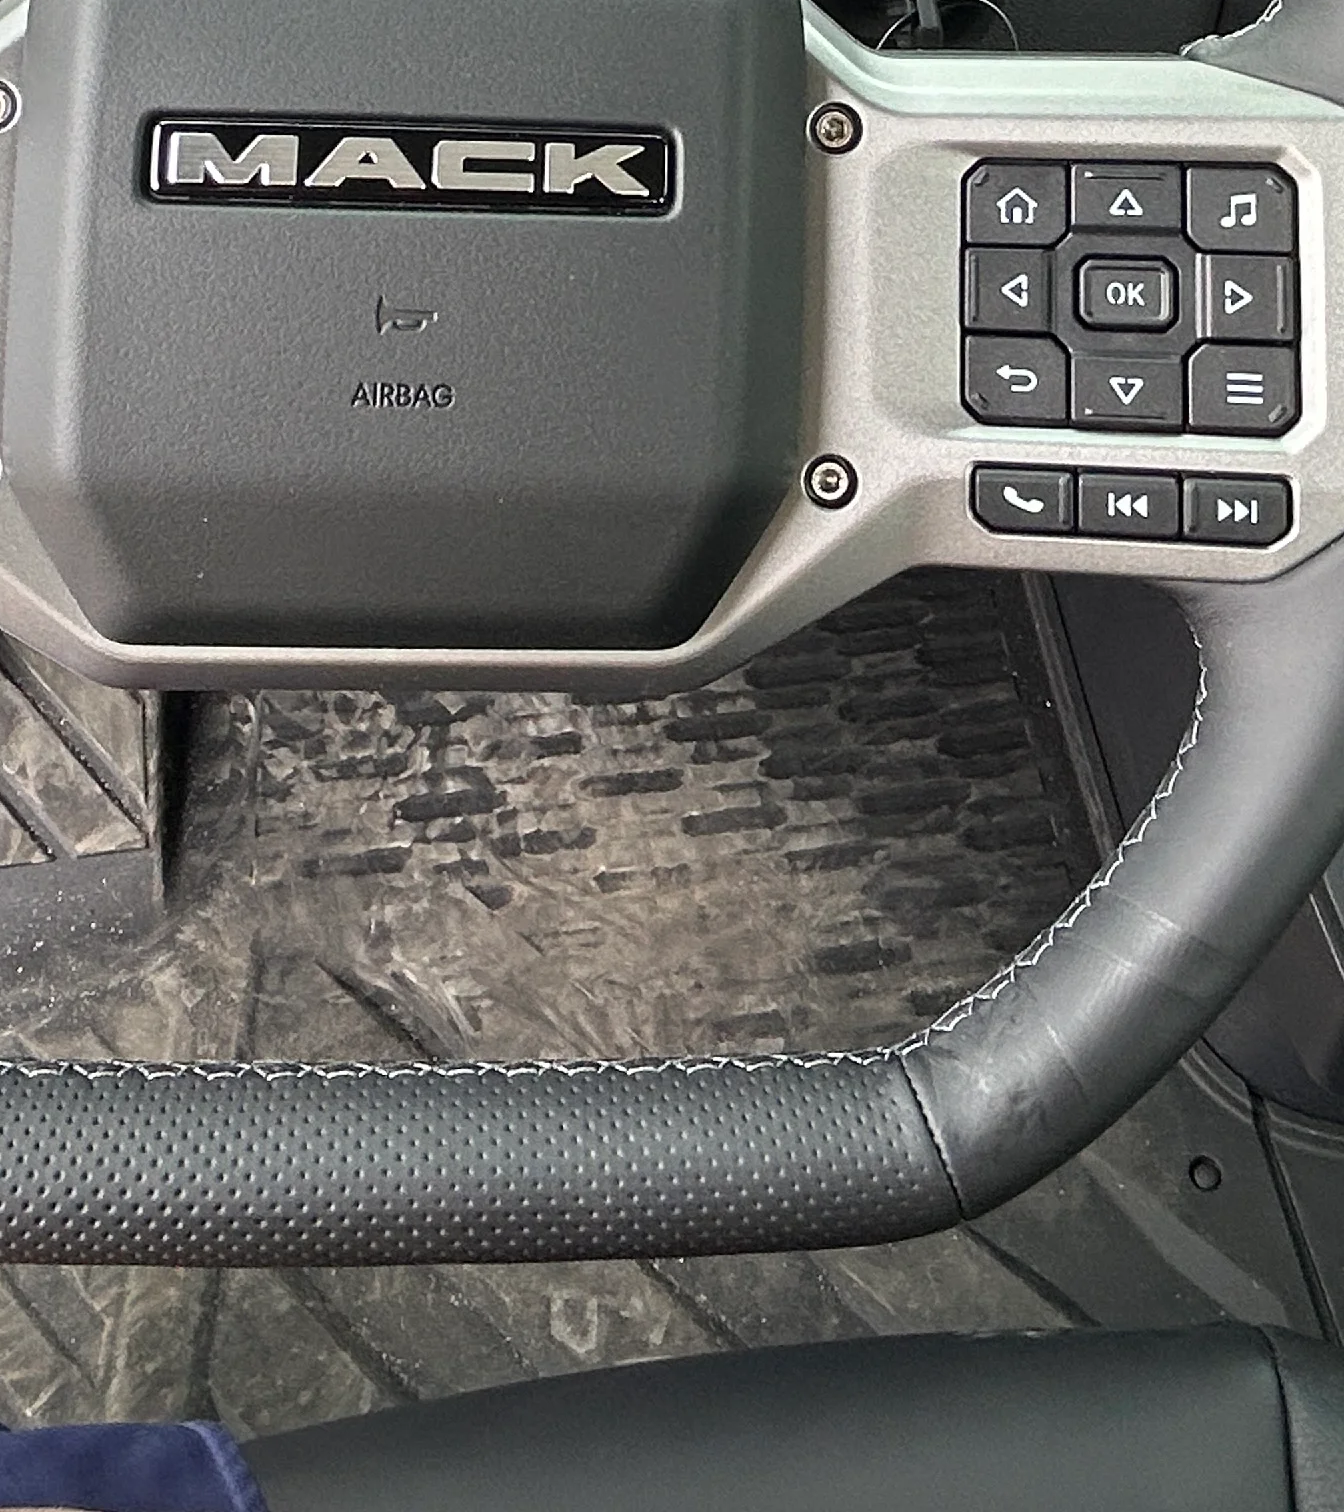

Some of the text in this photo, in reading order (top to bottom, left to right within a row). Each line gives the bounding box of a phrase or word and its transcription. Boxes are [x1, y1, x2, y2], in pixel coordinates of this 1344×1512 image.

[168, 132, 650, 196] MACK
[1106, 281, 1146, 307] OK
[350, 382, 455, 409] AIRBAG
